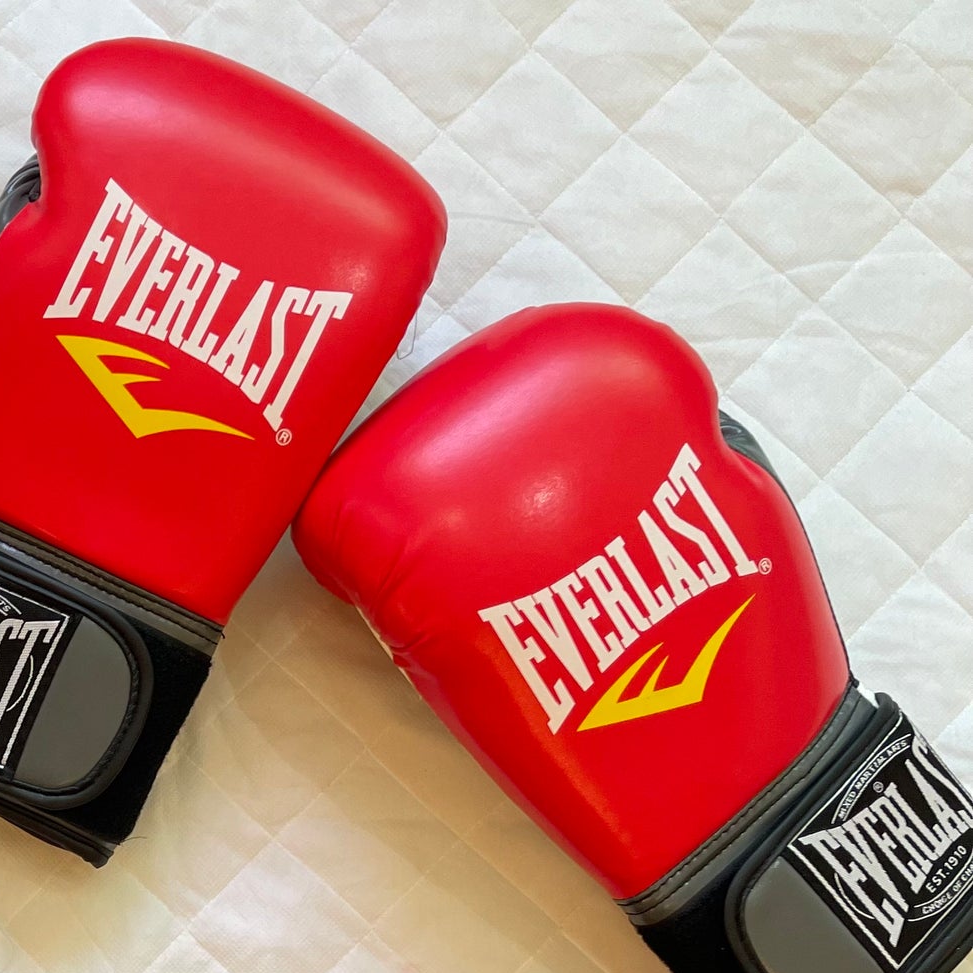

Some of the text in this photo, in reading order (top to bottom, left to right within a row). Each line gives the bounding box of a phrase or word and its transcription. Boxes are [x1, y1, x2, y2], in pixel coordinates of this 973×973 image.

[42, 177, 354, 432] EVERLAST
[477, 442, 758, 735] EVERLAST
[798, 735, 973, 947] EVERLAS
[922, 879, 963, 914] CHOICE OF
